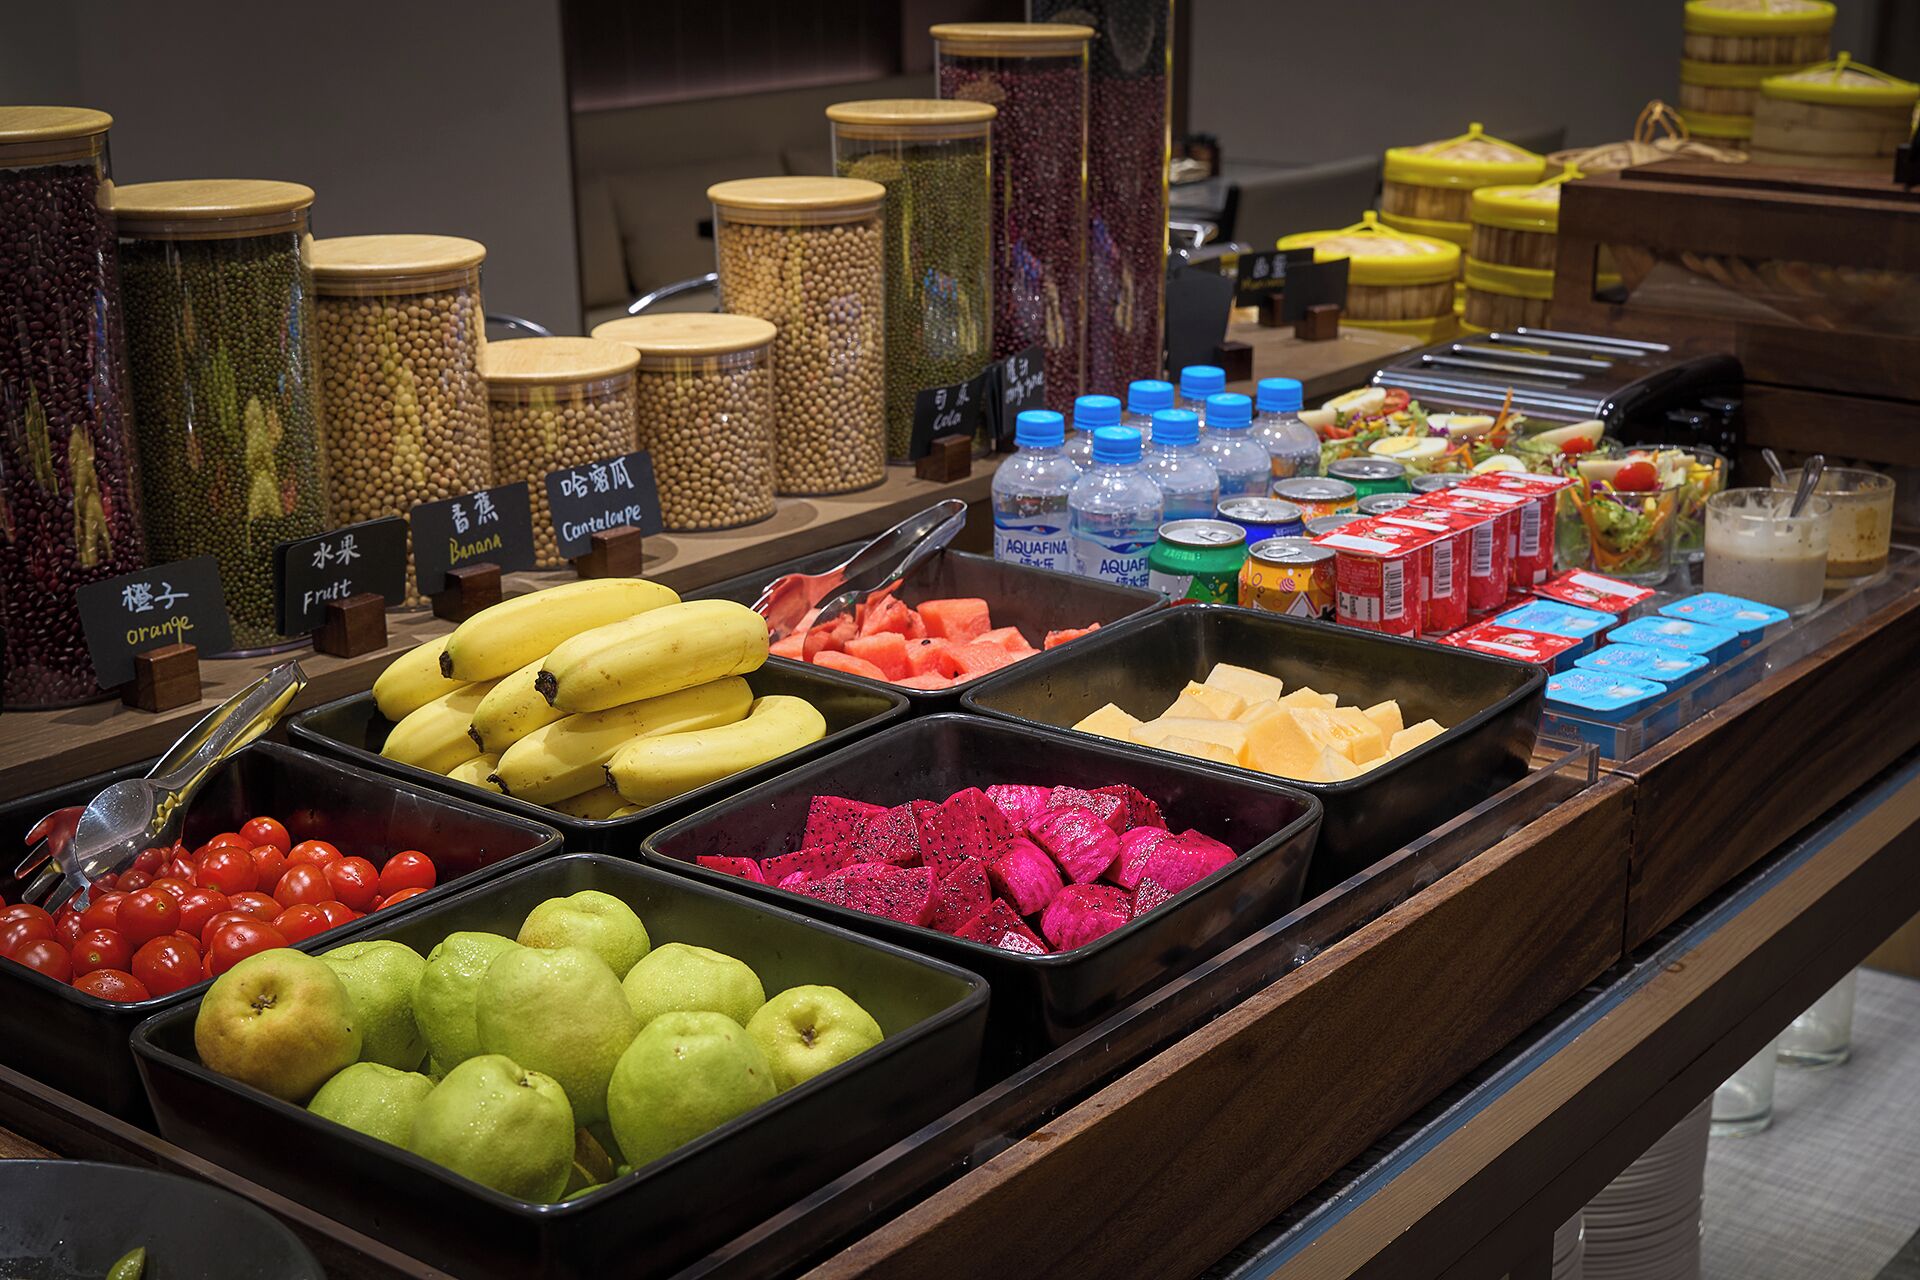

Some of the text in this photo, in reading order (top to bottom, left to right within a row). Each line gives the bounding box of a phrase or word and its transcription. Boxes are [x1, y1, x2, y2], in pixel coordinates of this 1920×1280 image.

[932, 409, 962, 431] Cola
[560, 456, 635, 498] 哈密瓜
[451, 491, 499, 534] 香蕉
[311, 533, 361, 570] 水果
[448, 533, 502, 565] Banana
[1005, 538, 1069, 558] AQUAFINA
[121, 582, 190, 614] 橙子
[303, 578, 352, 615] Fruit
[126, 615, 195, 645] orange
